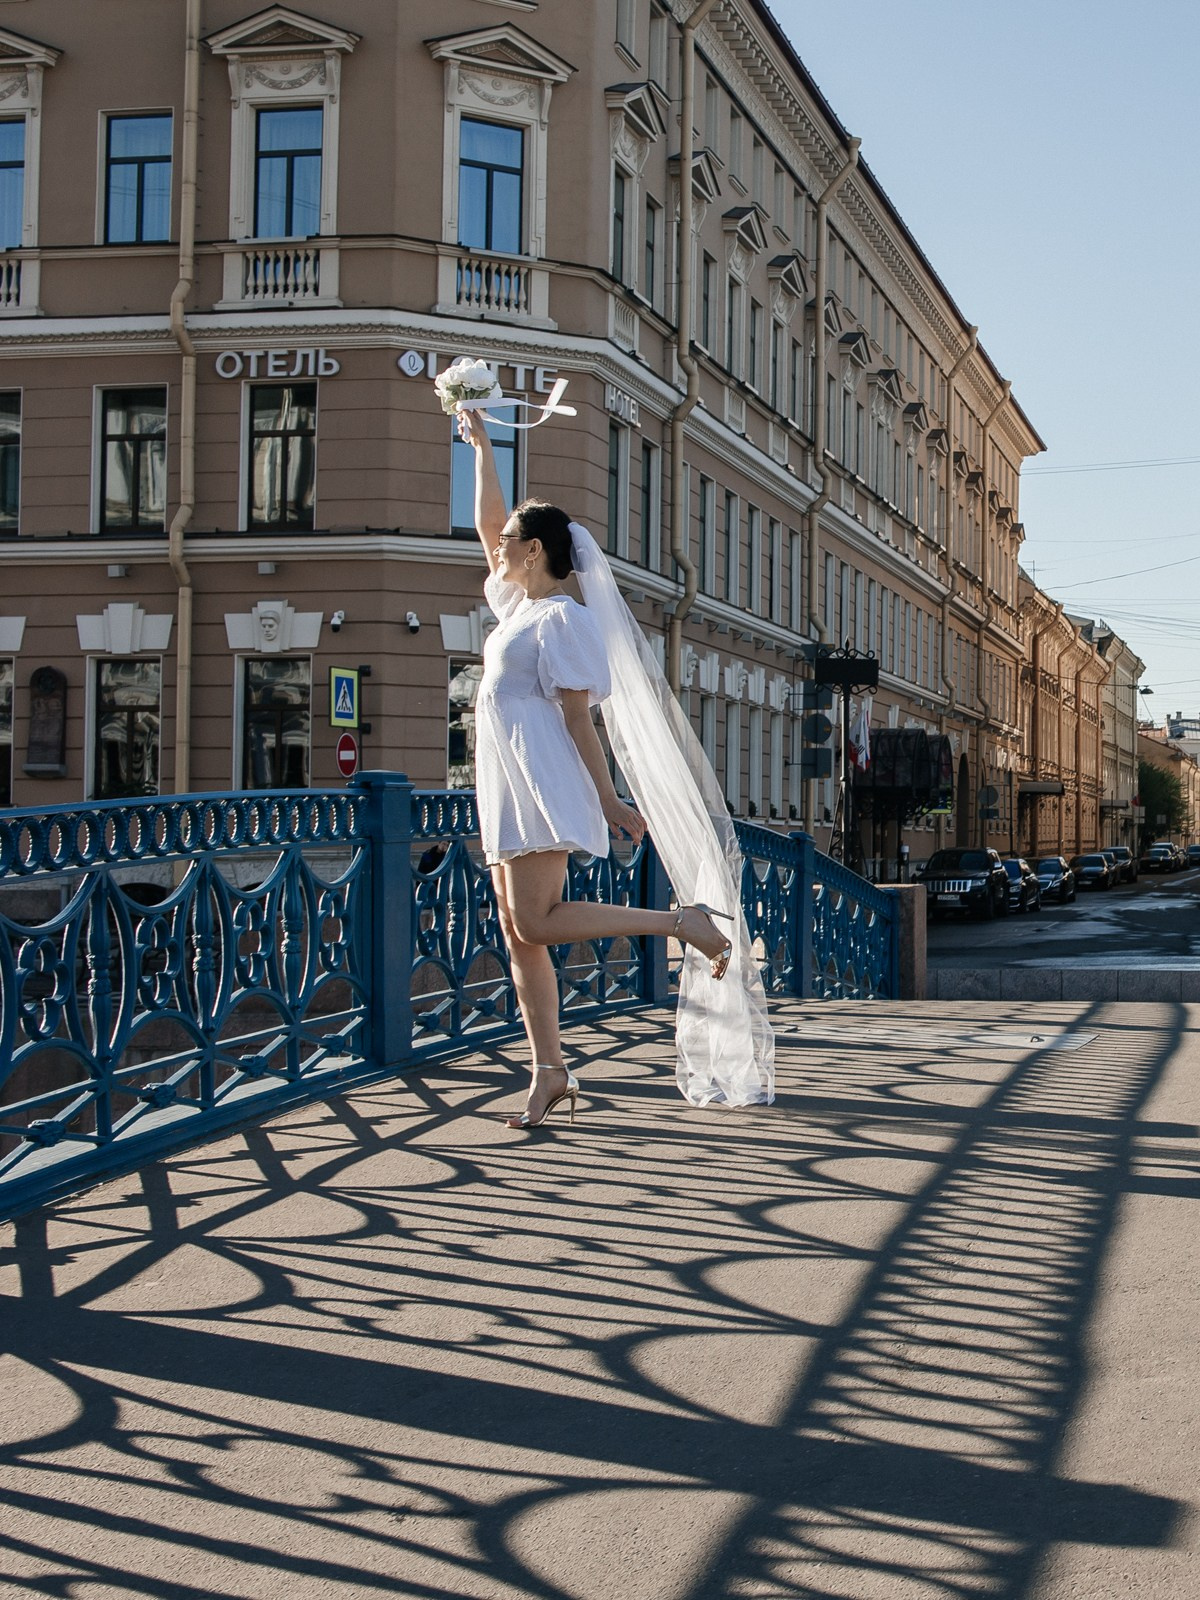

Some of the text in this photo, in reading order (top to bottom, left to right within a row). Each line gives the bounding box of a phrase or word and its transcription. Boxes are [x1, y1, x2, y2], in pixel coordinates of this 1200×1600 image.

[215, 349, 340, 379] ОТЕЛЬ
[427, 351, 559, 393] LTTE
[605, 383, 642, 428] HOTEL
